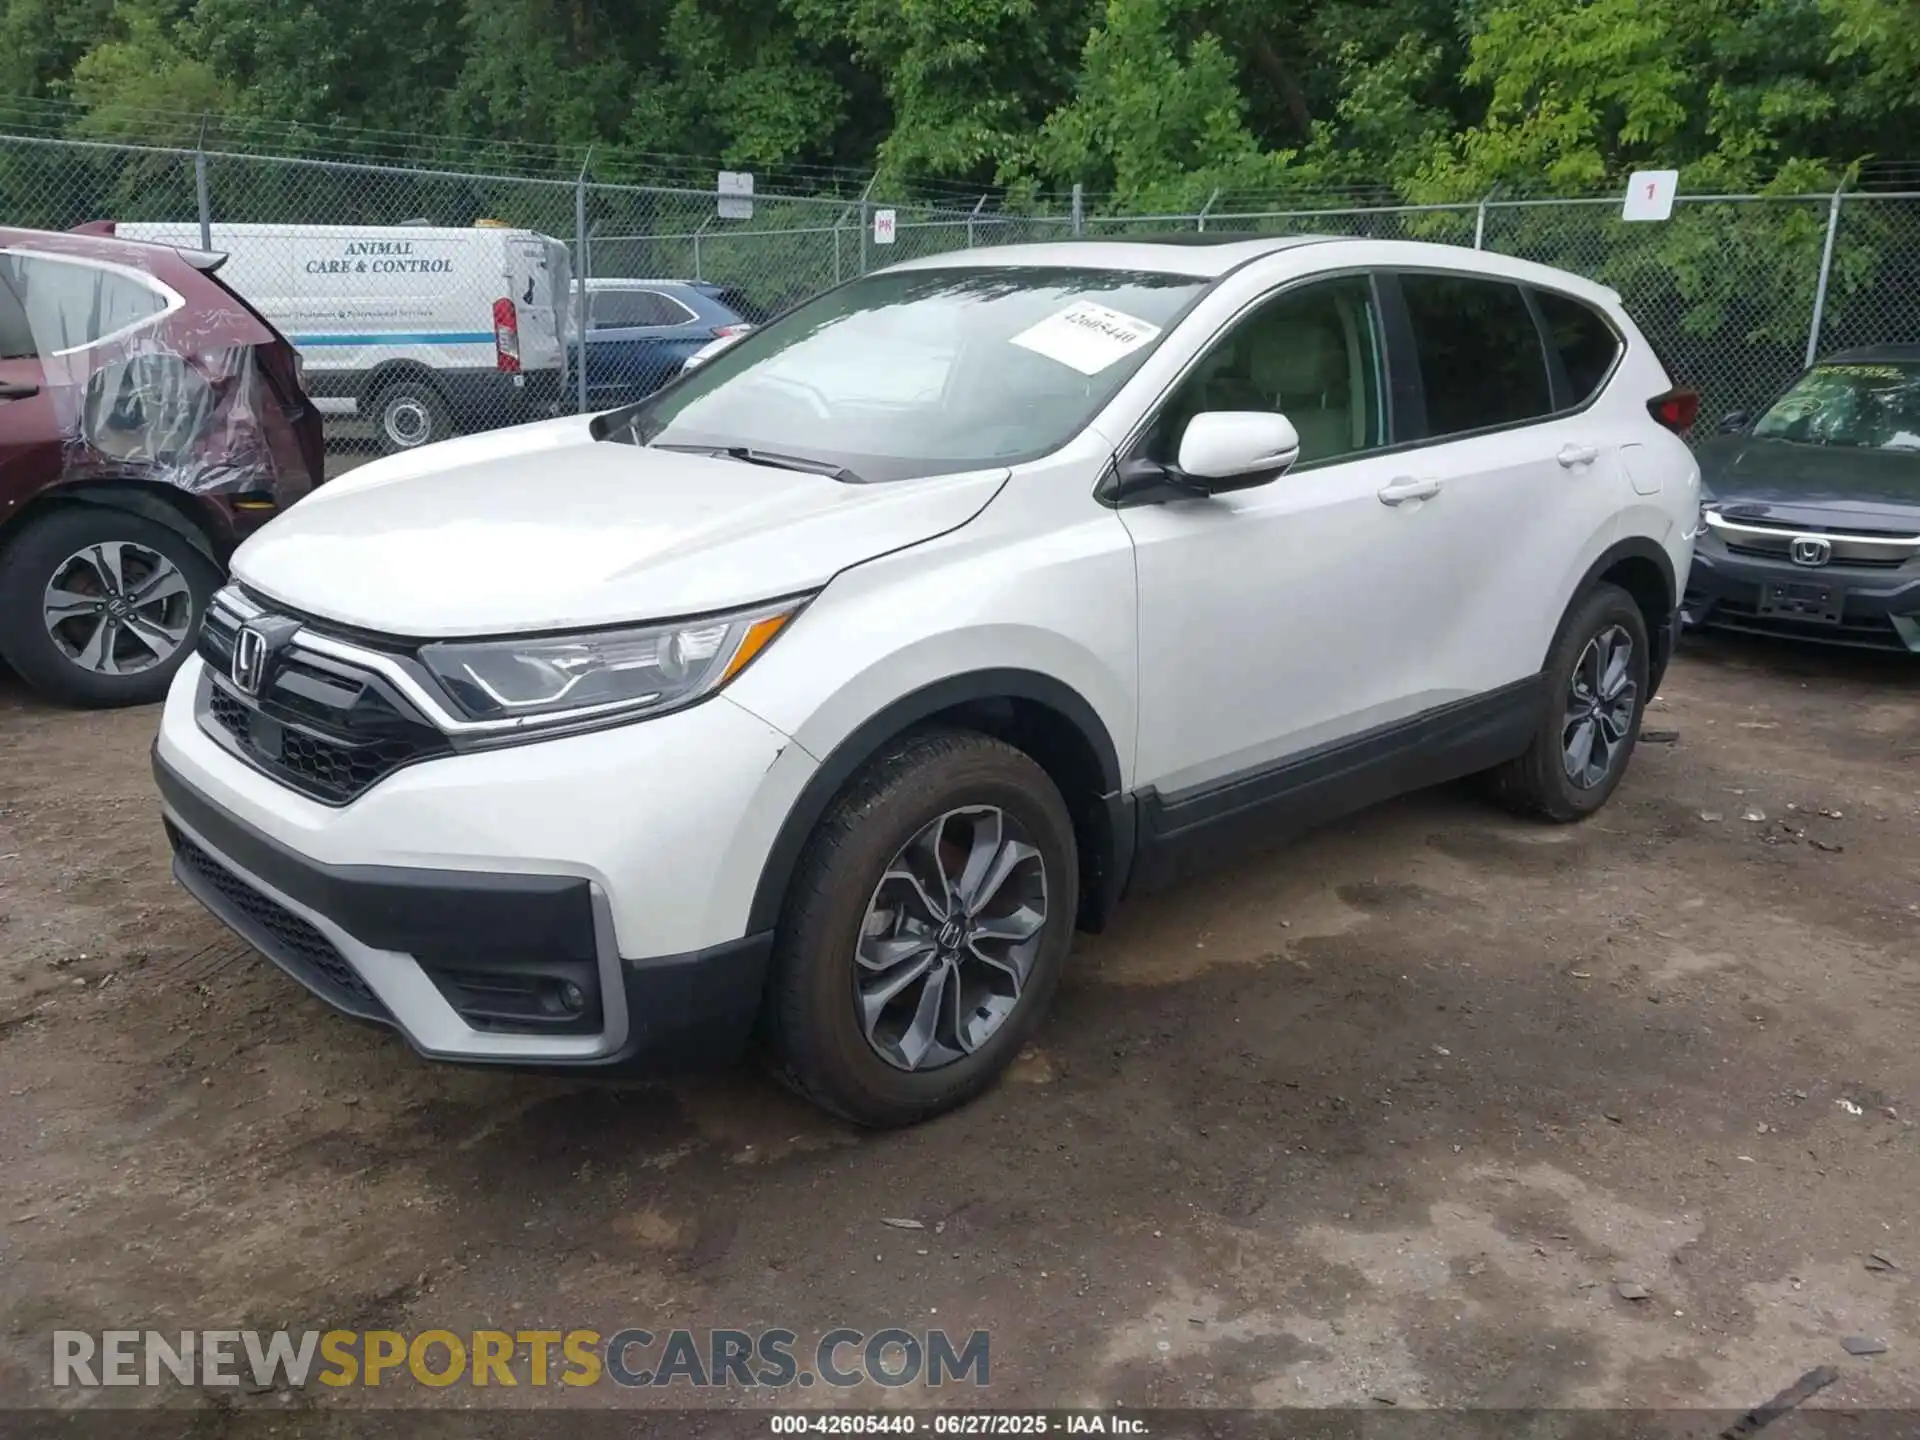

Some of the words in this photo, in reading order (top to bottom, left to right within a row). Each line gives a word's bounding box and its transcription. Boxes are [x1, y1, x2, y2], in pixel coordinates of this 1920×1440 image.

[1645, 183, 1656, 200] 1
[345, 242, 414, 256] ANIMAL
[306, 260, 351, 273] CARE
[355, 260, 366, 273] &
[372, 259, 454, 273] CONTROL
